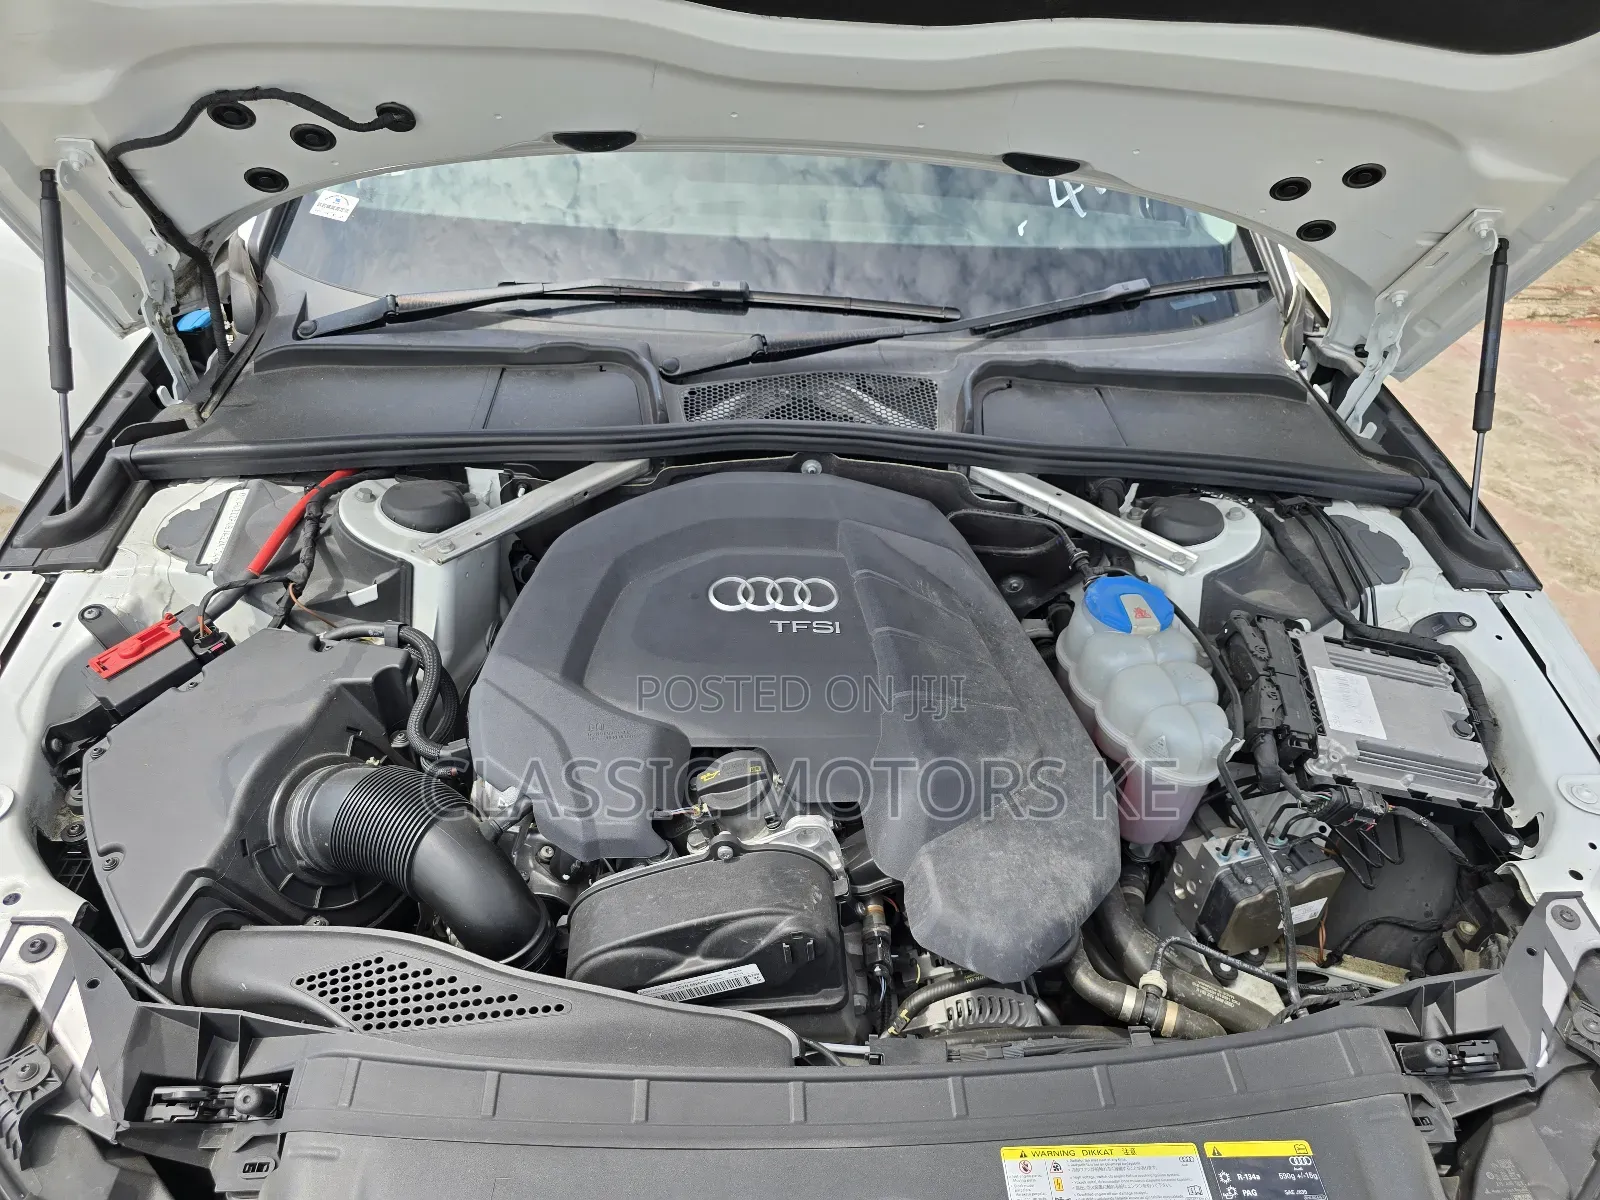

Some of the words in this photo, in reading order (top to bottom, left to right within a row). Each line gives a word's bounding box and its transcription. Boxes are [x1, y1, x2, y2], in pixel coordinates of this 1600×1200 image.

[769, 619, 841, 634] TFSI
[1031, 1149, 1076, 1158] WARNING
[1081, 1148, 1114, 1157] DIKKAT
[1236, 1173, 1261, 1181] R-134a
[1242, 1188, 1258, 1197] PAG
